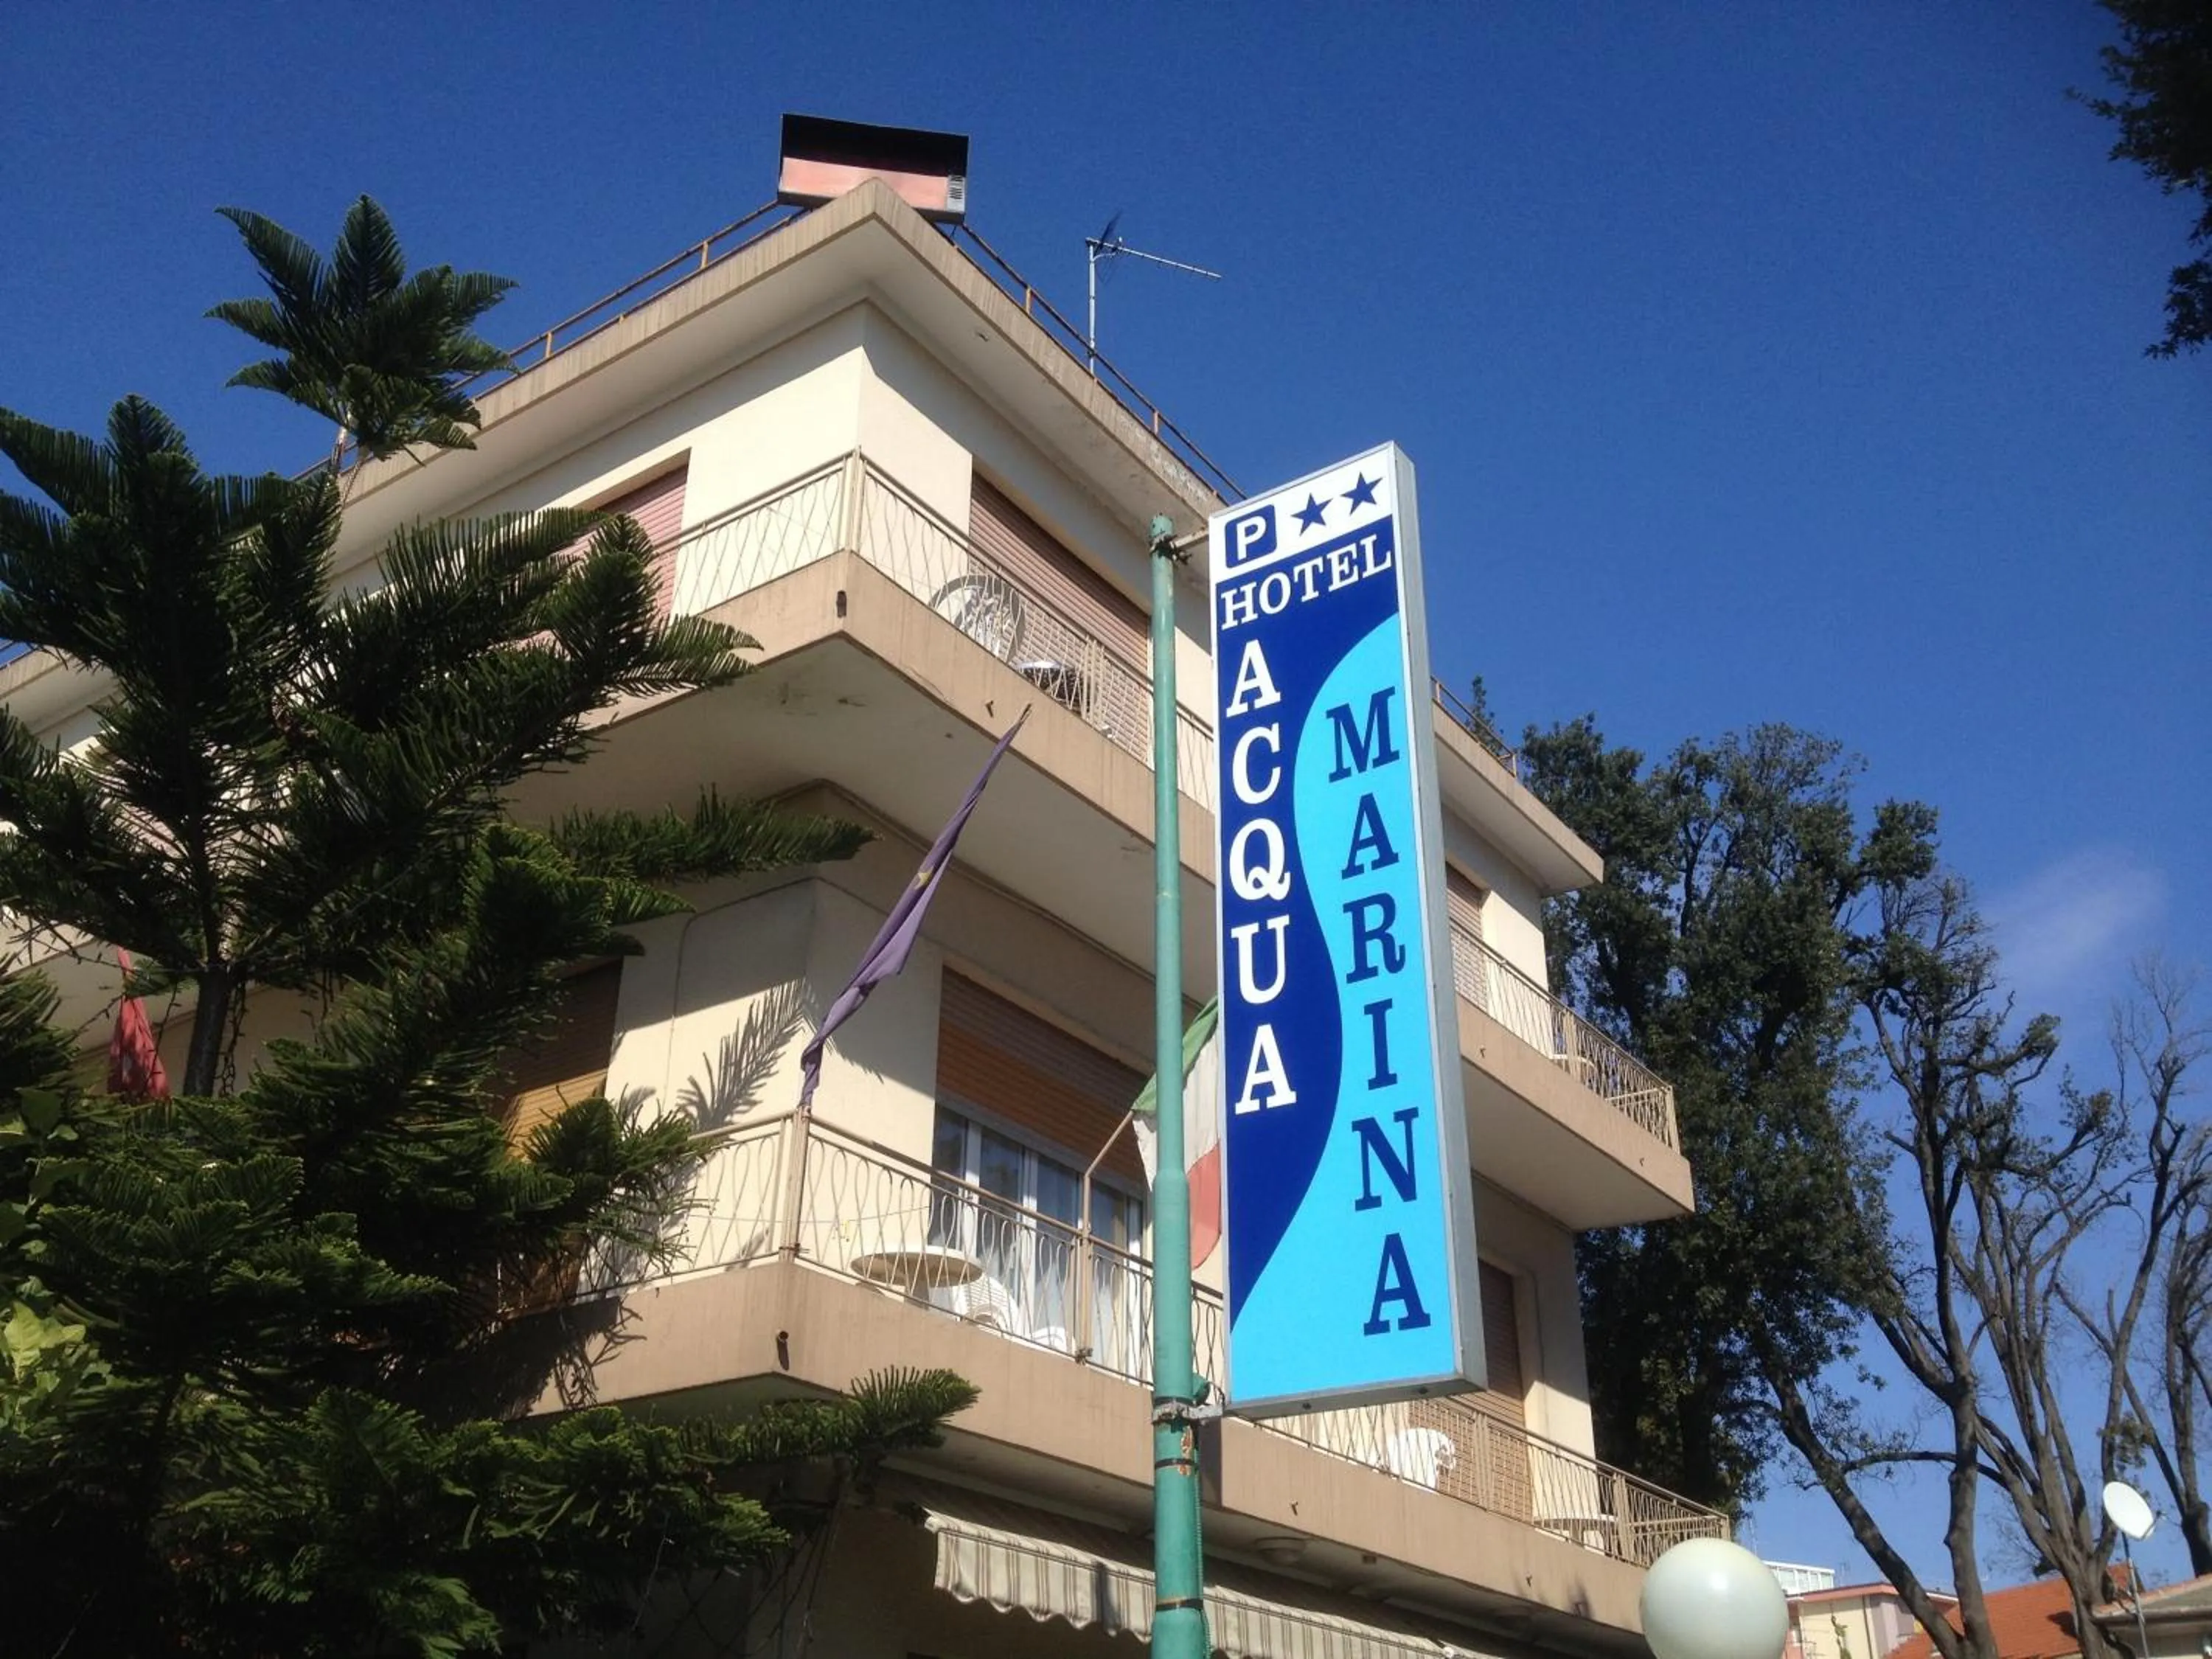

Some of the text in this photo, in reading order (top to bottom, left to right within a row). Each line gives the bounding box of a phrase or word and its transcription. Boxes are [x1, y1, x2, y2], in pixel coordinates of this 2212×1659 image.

[1220, 535, 1393, 630] HOTEL
[1236, 515, 1267, 560] P
[1225, 639, 1297, 1116] ACQUA
[1325, 685, 1431, 1336] MARINA
